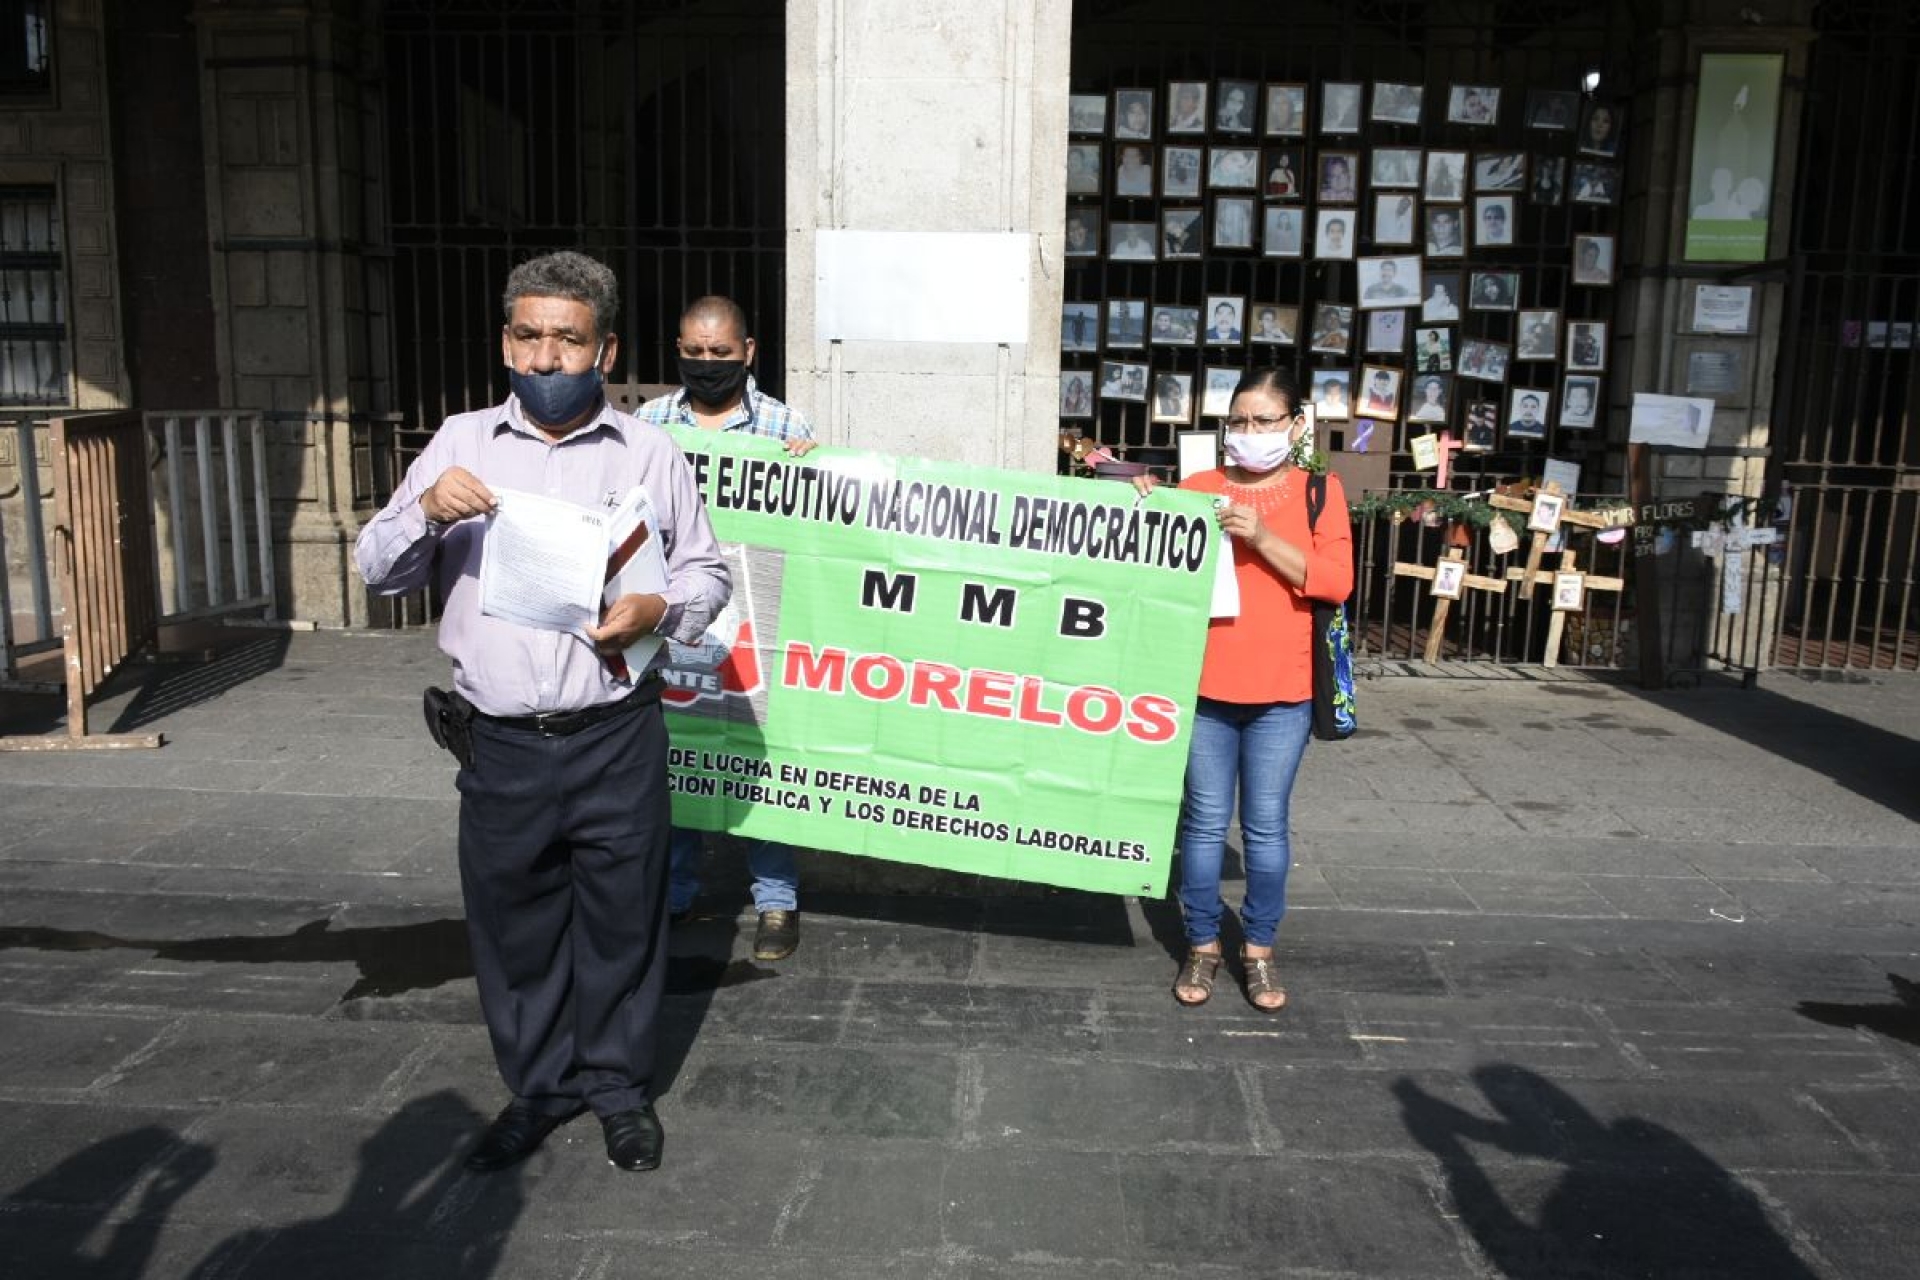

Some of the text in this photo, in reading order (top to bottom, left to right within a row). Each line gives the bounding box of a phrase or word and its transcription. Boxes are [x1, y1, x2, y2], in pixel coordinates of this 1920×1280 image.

[717, 456, 861, 526] EJECUTIVO
[866, 479, 1001, 545] NACIONAL
[1009, 496, 1207, 572] DEMOCRÁTICO
[1642, 502, 1693, 520] FLORES
[862, 570, 1105, 638] M M B
[783, 643, 1177, 742] MORELOS
[669, 748, 981, 811] DE LUCHA EN DEFENSA DE LA
[723, 776, 810, 811] PÚBLICA
[819, 796, 832, 814] Y
[845, 800, 885, 823] LOS
[892, 808, 1009, 841] DERECHOS
[1016, 828, 1151, 862] LABORALES.
